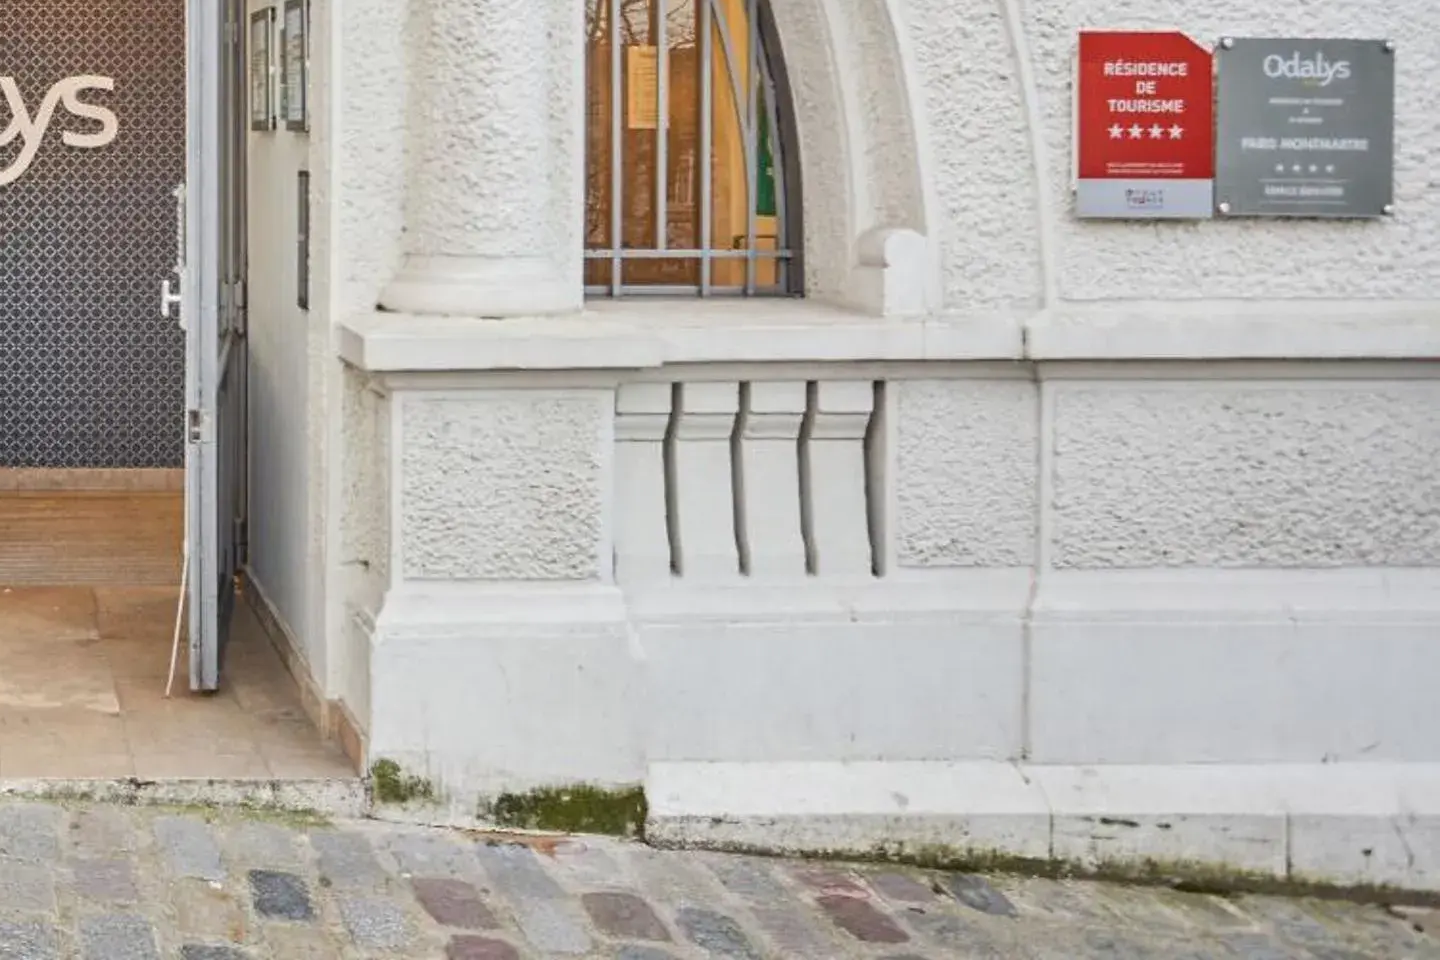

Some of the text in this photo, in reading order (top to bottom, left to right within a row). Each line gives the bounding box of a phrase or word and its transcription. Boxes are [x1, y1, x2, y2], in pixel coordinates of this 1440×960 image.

[1104, 59, 1188, 76] RÉSIDENCE
[1263, 50, 1352, 87] Odalys
[1136, 81, 1157, 95] DE
[1107, 99, 1185, 113] TOURISME
